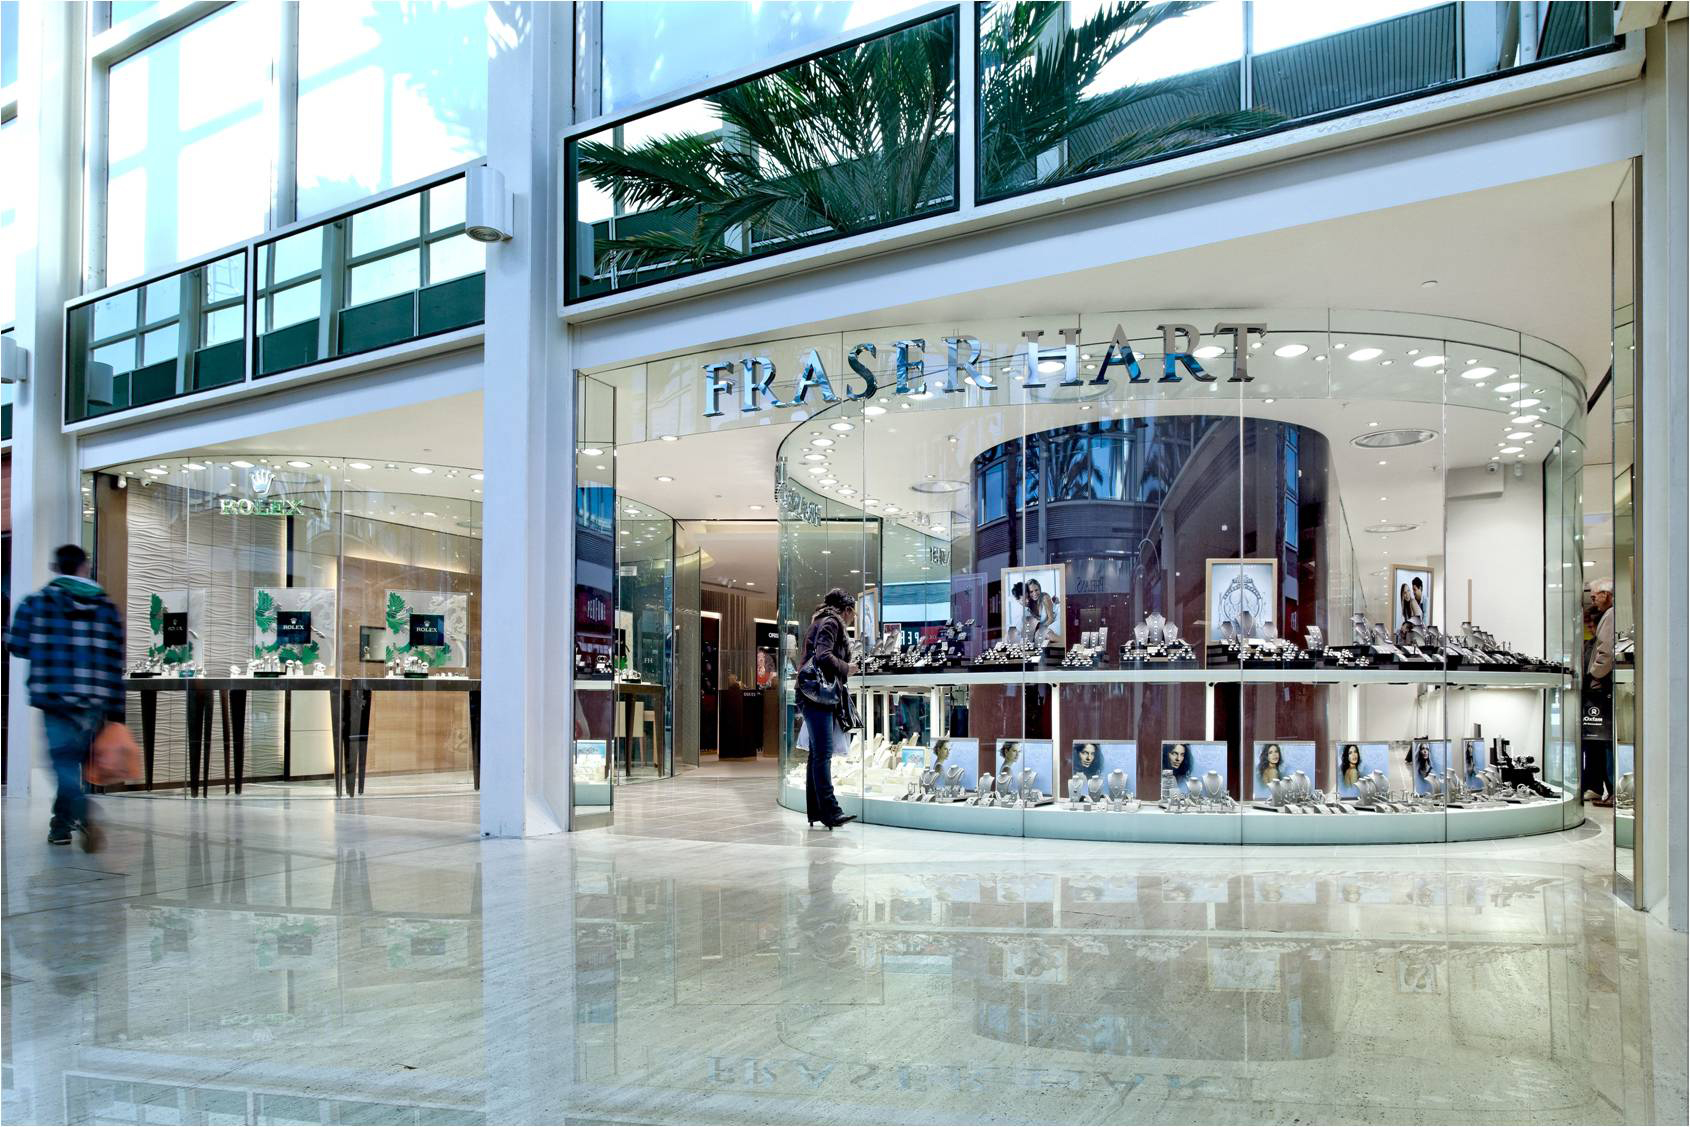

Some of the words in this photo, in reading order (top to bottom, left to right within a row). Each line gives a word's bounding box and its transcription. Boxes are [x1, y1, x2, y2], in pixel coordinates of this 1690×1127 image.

[703, 335, 998, 417] FRASER
[1021, 322, 1268, 389] HART
[220, 499, 304, 516] ROLEX
